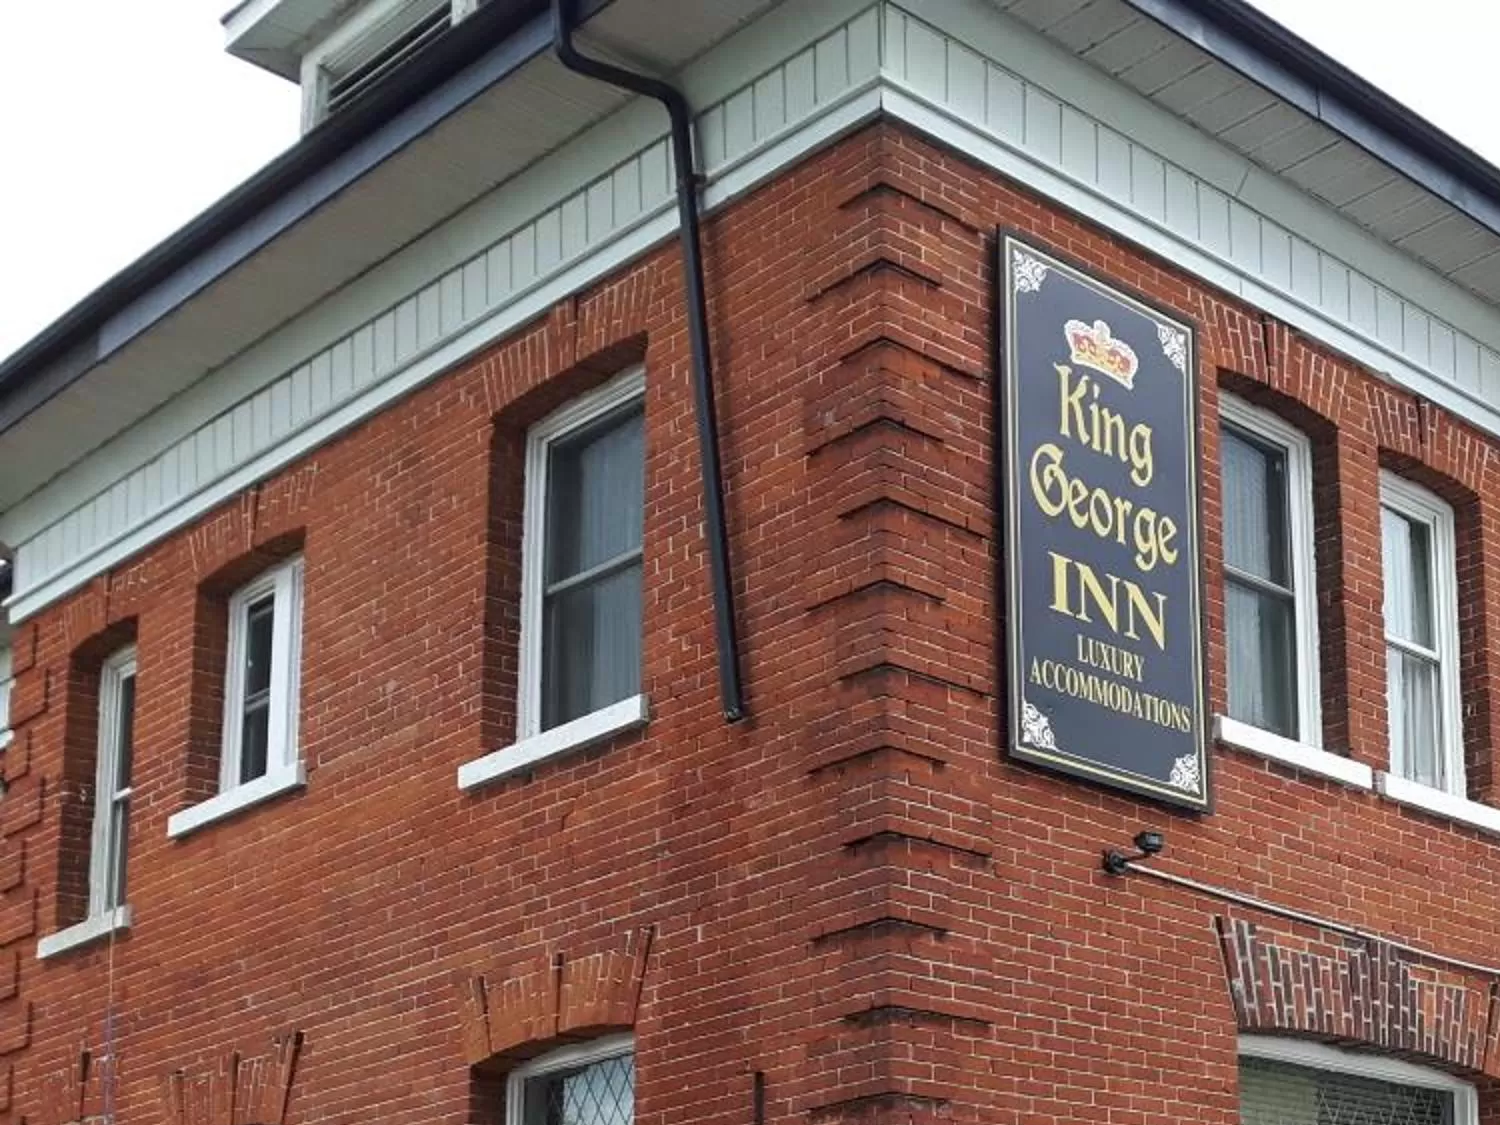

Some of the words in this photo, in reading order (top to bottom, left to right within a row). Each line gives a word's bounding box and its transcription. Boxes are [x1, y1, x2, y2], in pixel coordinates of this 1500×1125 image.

[1053, 361, 1153, 487] King
[1029, 442, 1179, 571] George
[1048, 551, 1168, 651] INN
[1029, 655, 1191, 733] ACCOMMODATIONS
[1077, 633, 1145, 683] LUXURY
